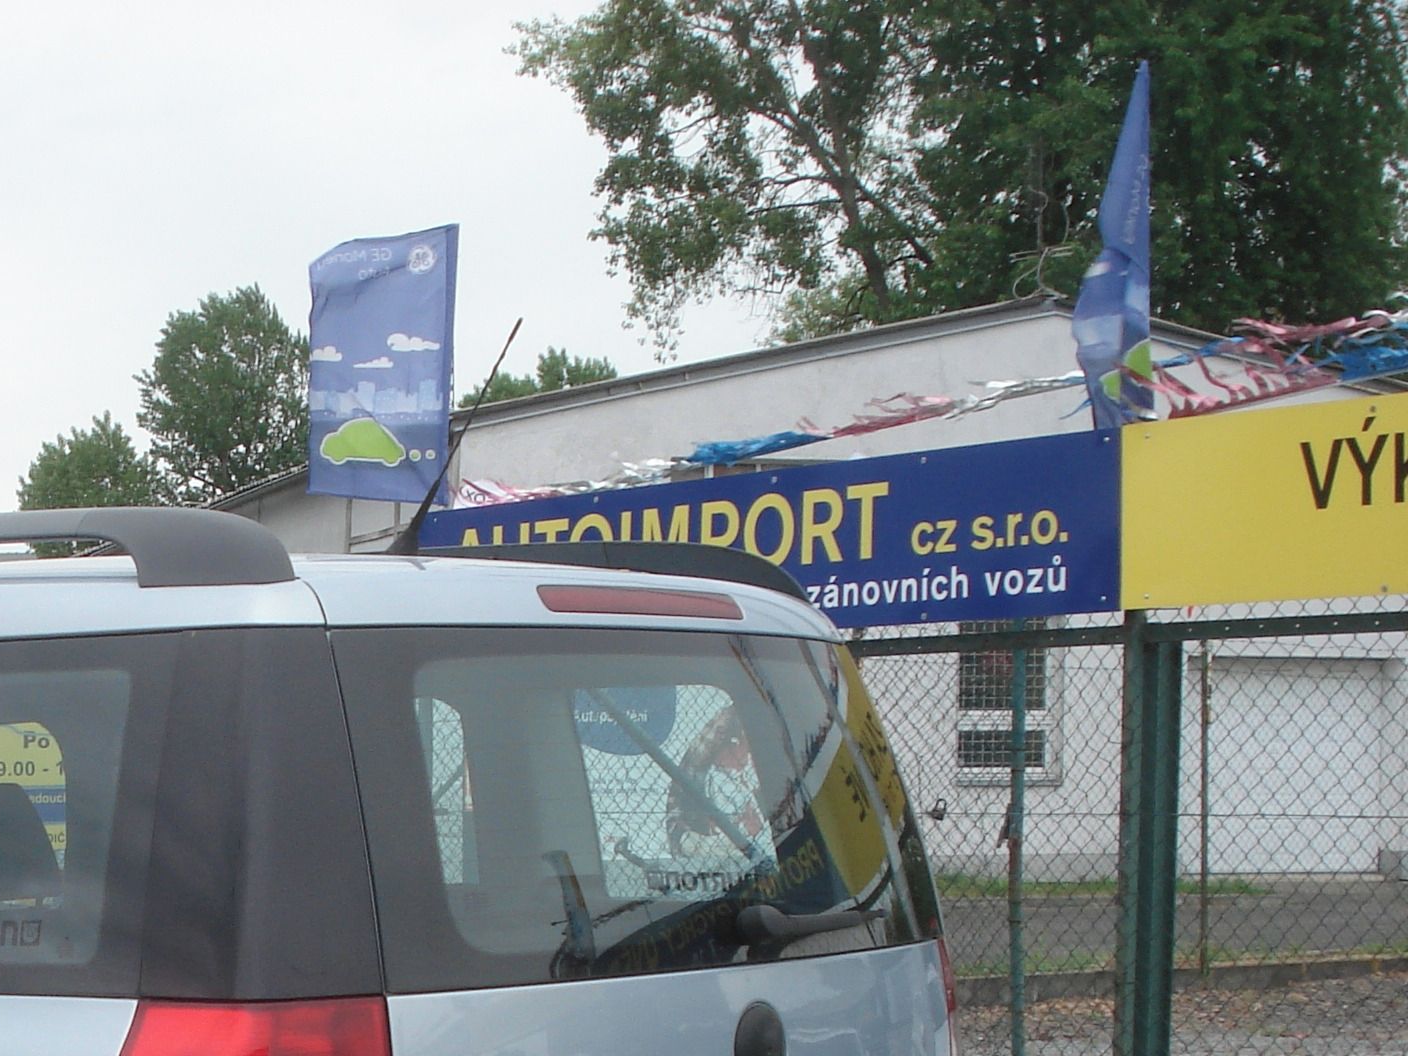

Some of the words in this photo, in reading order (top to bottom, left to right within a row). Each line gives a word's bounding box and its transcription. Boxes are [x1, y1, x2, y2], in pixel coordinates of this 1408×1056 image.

[460, 482, 889, 567] MPORT
[911, 520, 957, 555] cz
[970, 509, 1069, 551] s.r.o.
[806, 565, 969, 610] zánovních
[985, 554, 1067, 597] vozů
[23, 730, 51, 749] Po
